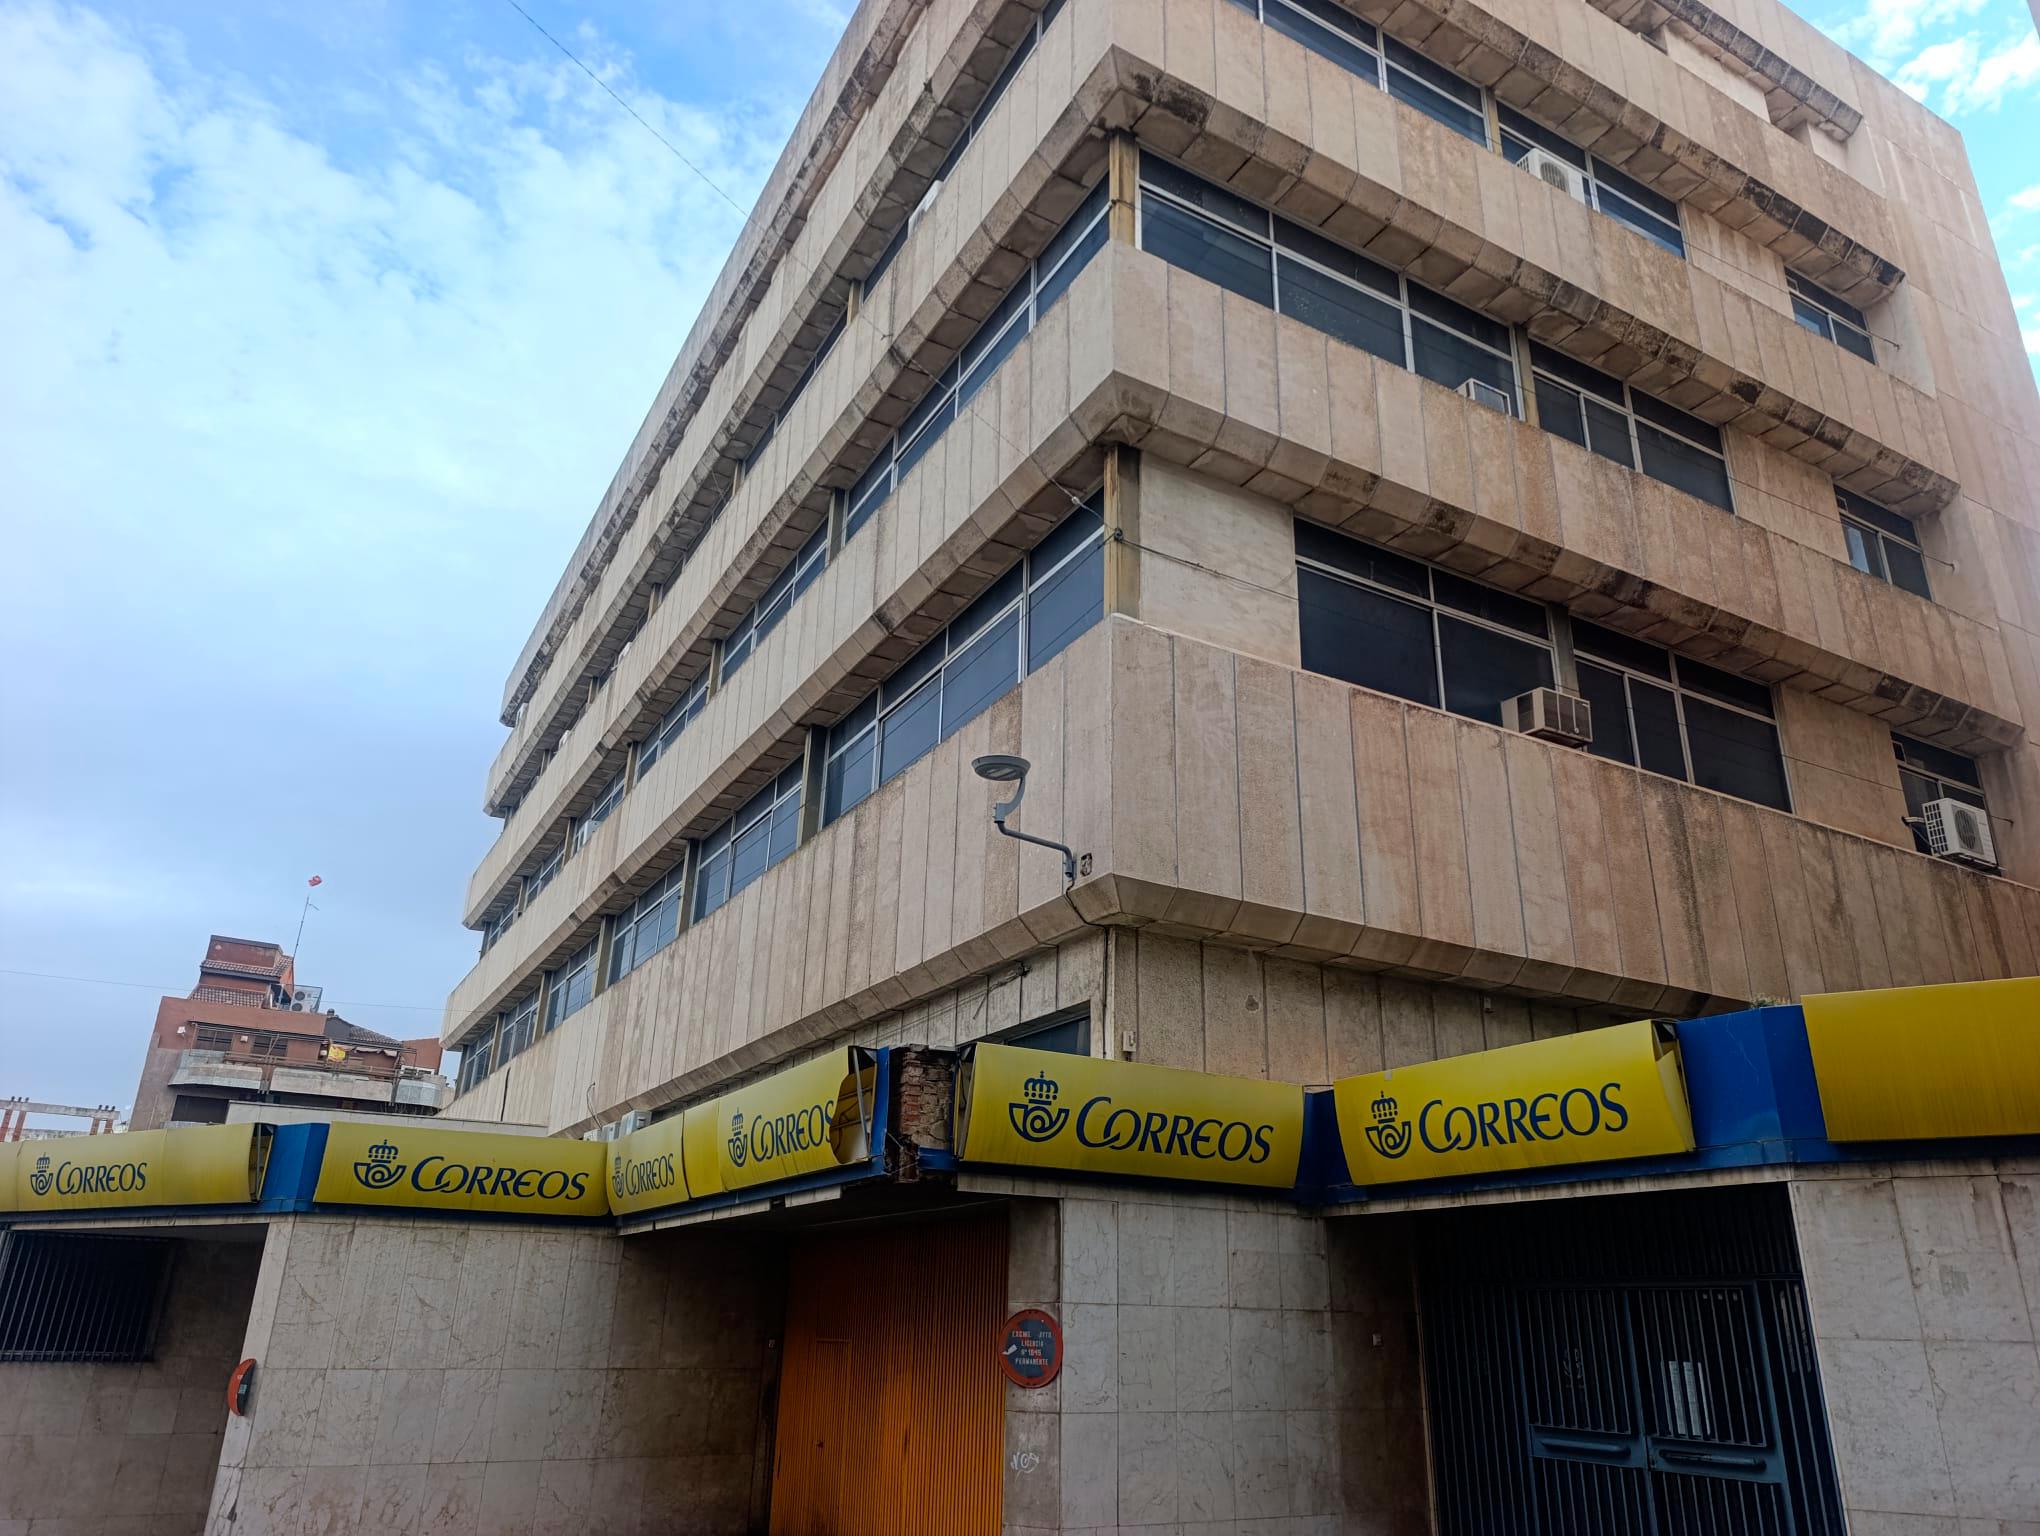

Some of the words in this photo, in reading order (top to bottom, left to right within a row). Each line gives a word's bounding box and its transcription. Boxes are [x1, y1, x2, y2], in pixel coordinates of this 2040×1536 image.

[1076, 1096, 1274, 1163] CORREOS
[1419, 1082, 1629, 1153] CORREOS
[56, 1161, 147, 1195] CORREOS
[411, 1156, 589, 1200] CORREOS
[625, 1153, 675, 1196] CORREOS
